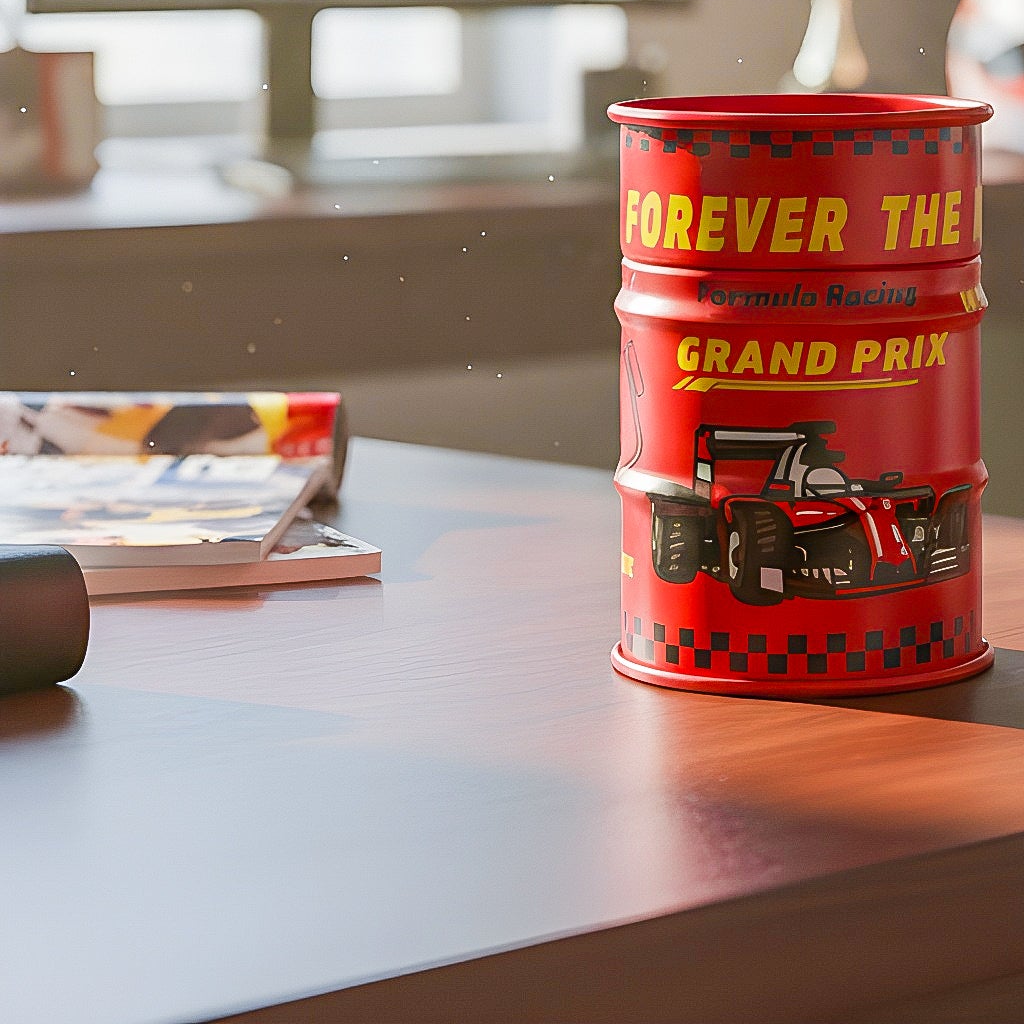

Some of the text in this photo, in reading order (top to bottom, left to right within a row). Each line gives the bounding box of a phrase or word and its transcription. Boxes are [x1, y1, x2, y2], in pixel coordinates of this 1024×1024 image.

[625, 189, 849, 253] FOREVER
[880, 189, 962, 251] THE
[676, 331, 949, 376] GRAND PRIX
